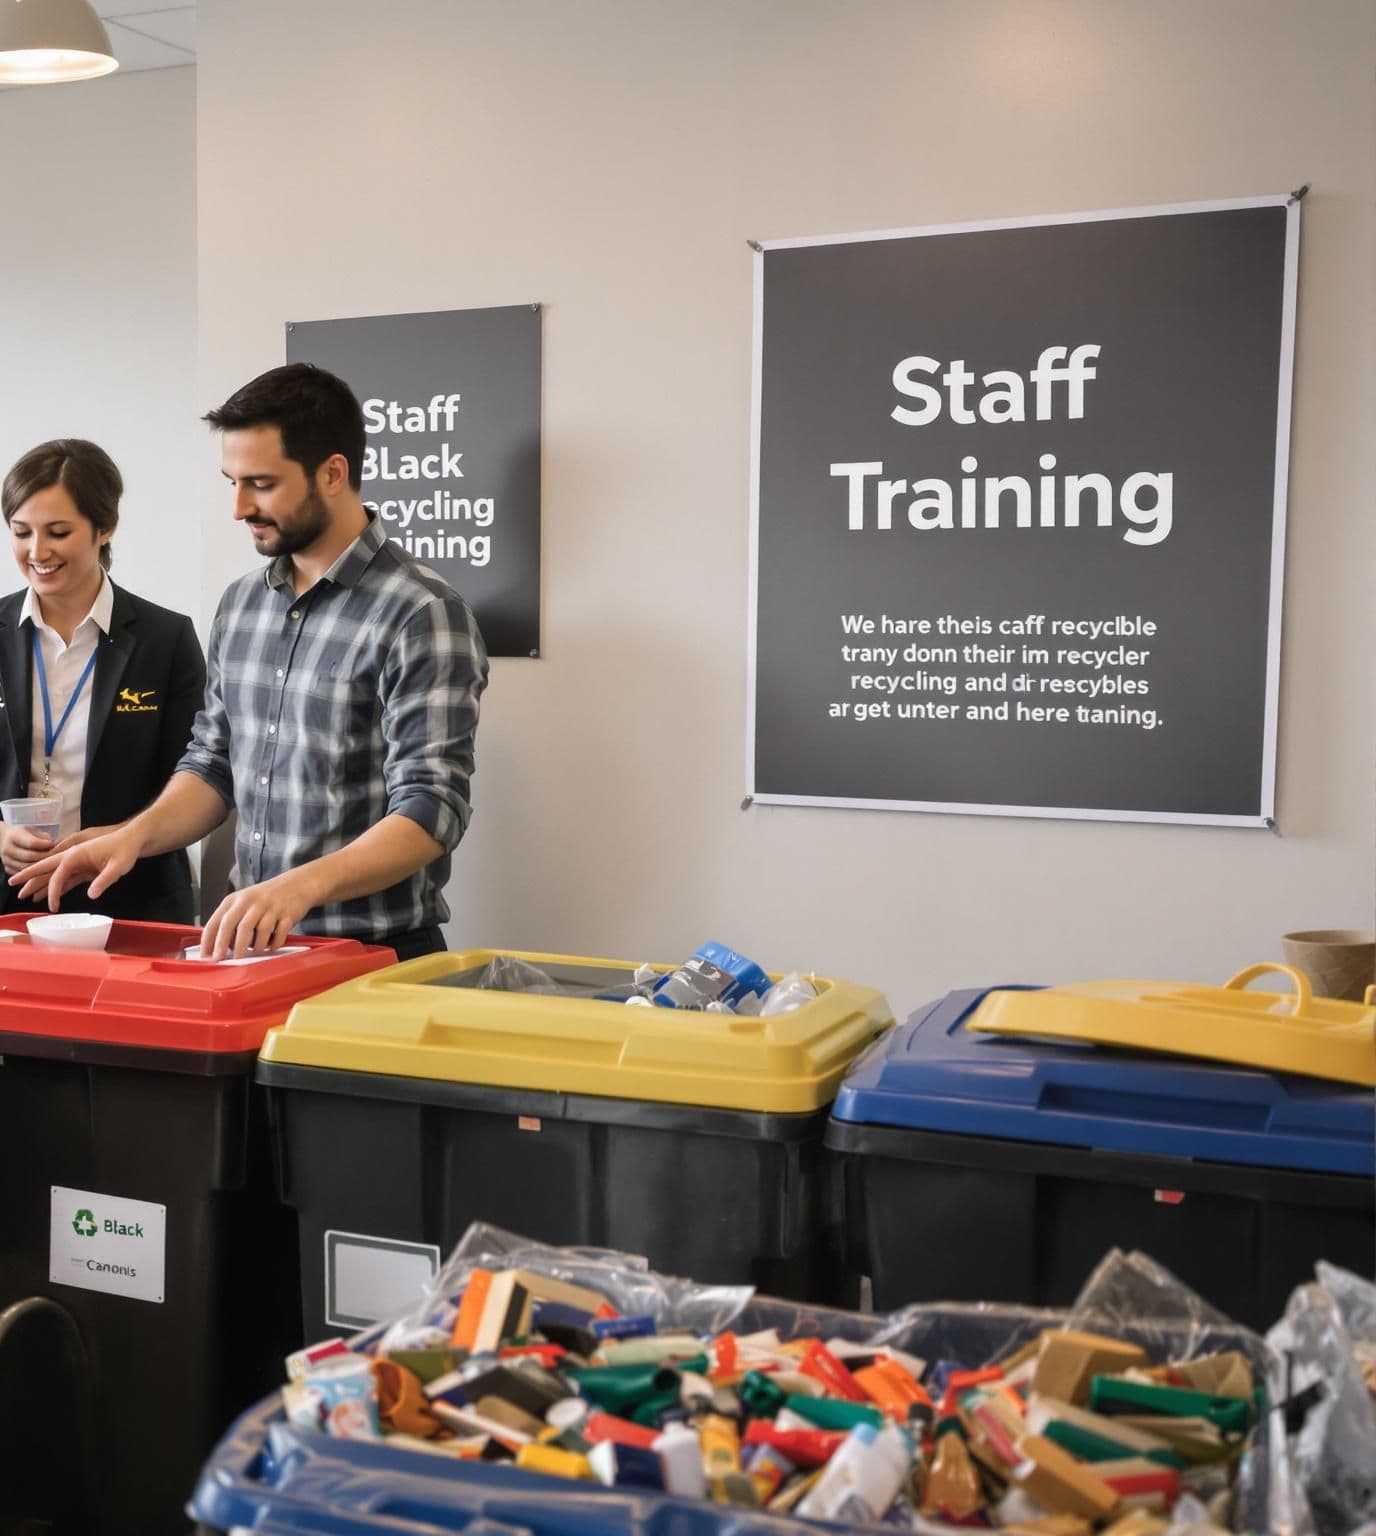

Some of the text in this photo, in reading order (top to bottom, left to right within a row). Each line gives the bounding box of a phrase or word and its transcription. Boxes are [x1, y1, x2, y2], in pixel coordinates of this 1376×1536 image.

[890, 344, 1102, 426] Staff
[362, 394, 461, 434] Staff
[360, 489, 495, 528] cycling
[829, 453, 1174, 546] Training
[388, 528, 491, 567] ining
[840, 614, 876, 635] We
[881, 614, 932, 635] hare
[936, 614, 993, 635] theis
[998, 614, 1046, 635] caff
[840, 642, 1151, 670] trany donn their im recycler
[850, 670, 958, 695] recycling
[964, 672, 1007, 692] and
[1040, 674, 1149, 698] rescybles
[897, 701, 961, 720] unter
[965, 700, 1009, 721] and
[1016, 701, 1070, 723] here
[103, 1219, 144, 1238] Black
